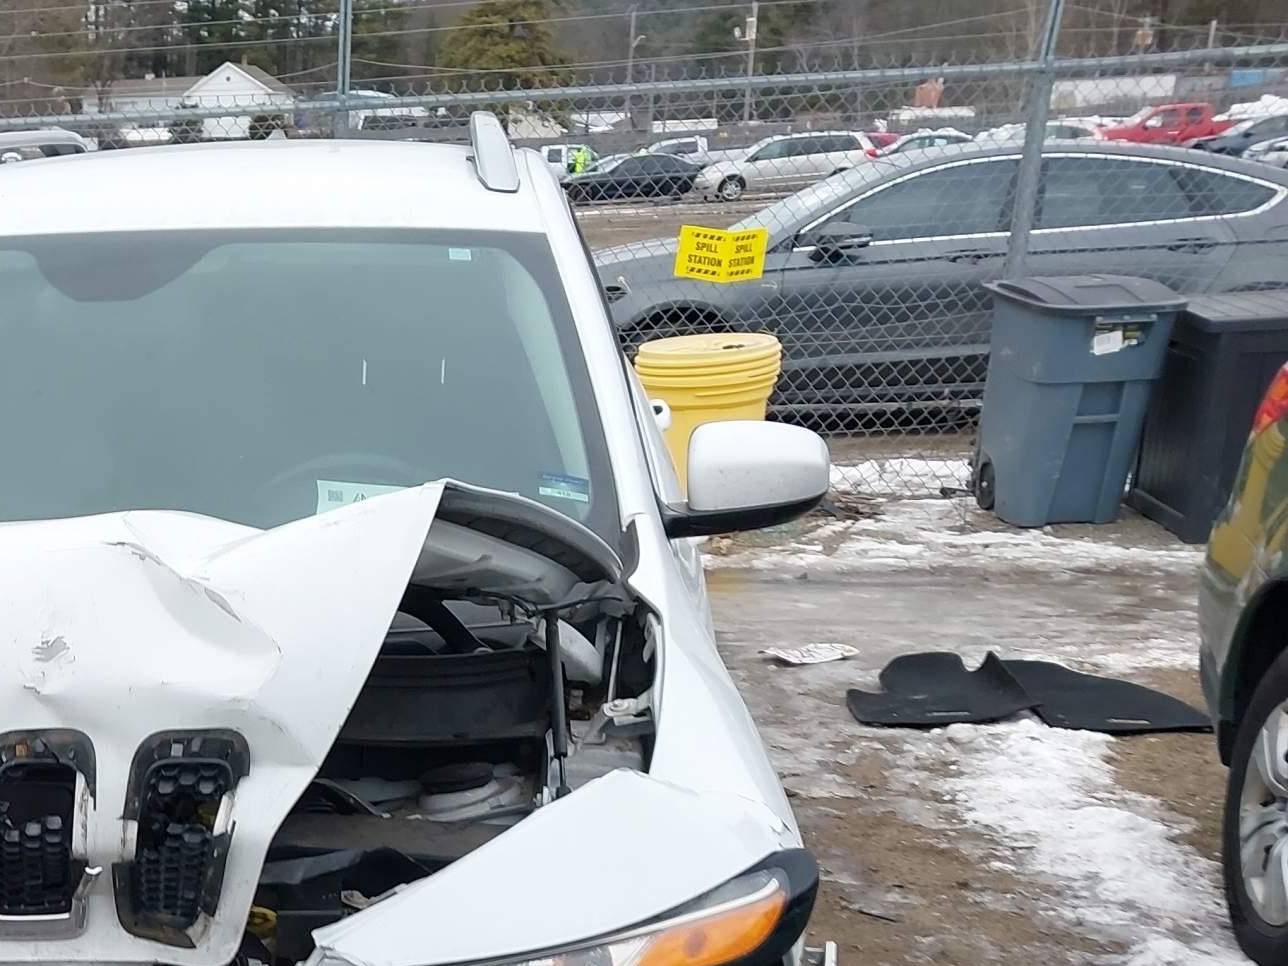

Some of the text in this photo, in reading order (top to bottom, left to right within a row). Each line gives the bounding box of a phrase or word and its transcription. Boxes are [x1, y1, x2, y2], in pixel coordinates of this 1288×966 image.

[695, 241, 718, 254] SPILL
[734, 243, 752, 254] SPILL
[687, 254, 722, 267] STATION
[728, 256, 755, 268] STATION
